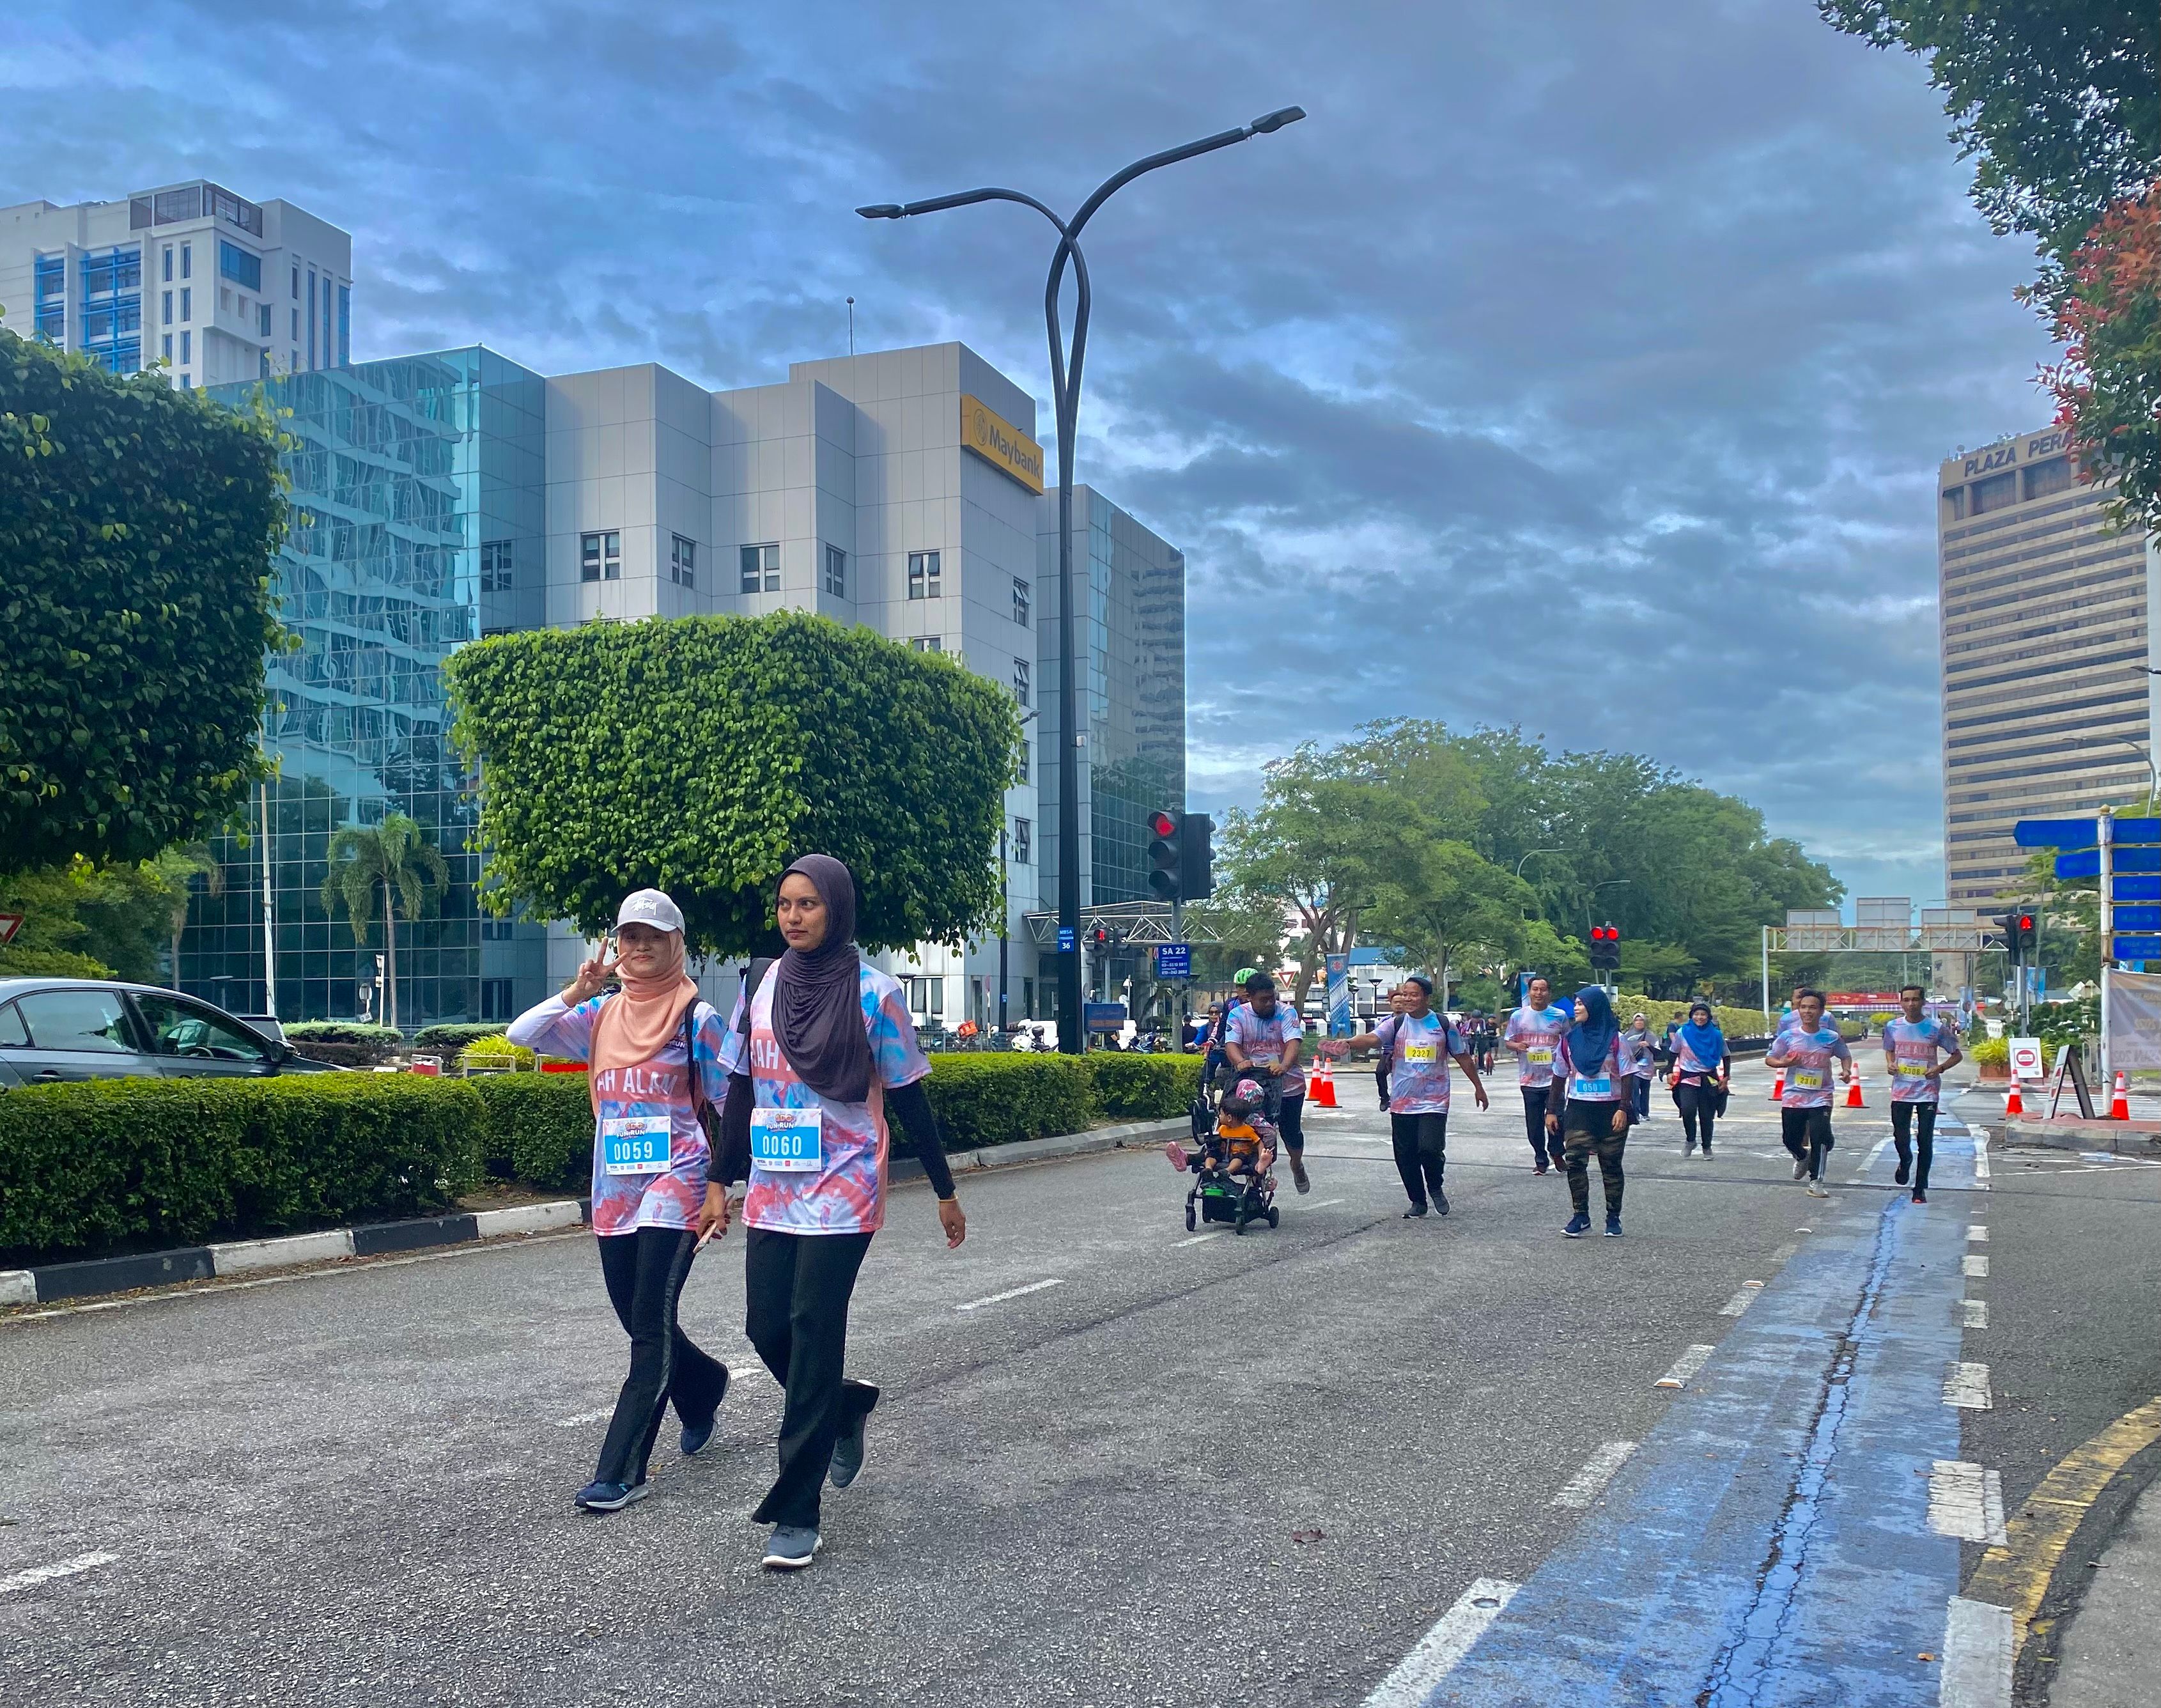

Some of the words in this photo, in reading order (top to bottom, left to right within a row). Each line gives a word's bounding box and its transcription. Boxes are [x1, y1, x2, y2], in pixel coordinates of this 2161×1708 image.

[989, 424, 1040, 479] Maybank
[1964, 446, 2017, 477] PLAZA
[1583, 1083, 1603, 1092] 0501
[614, 1141, 653, 1161] 0059
[763, 1135, 802, 1156] 0060
